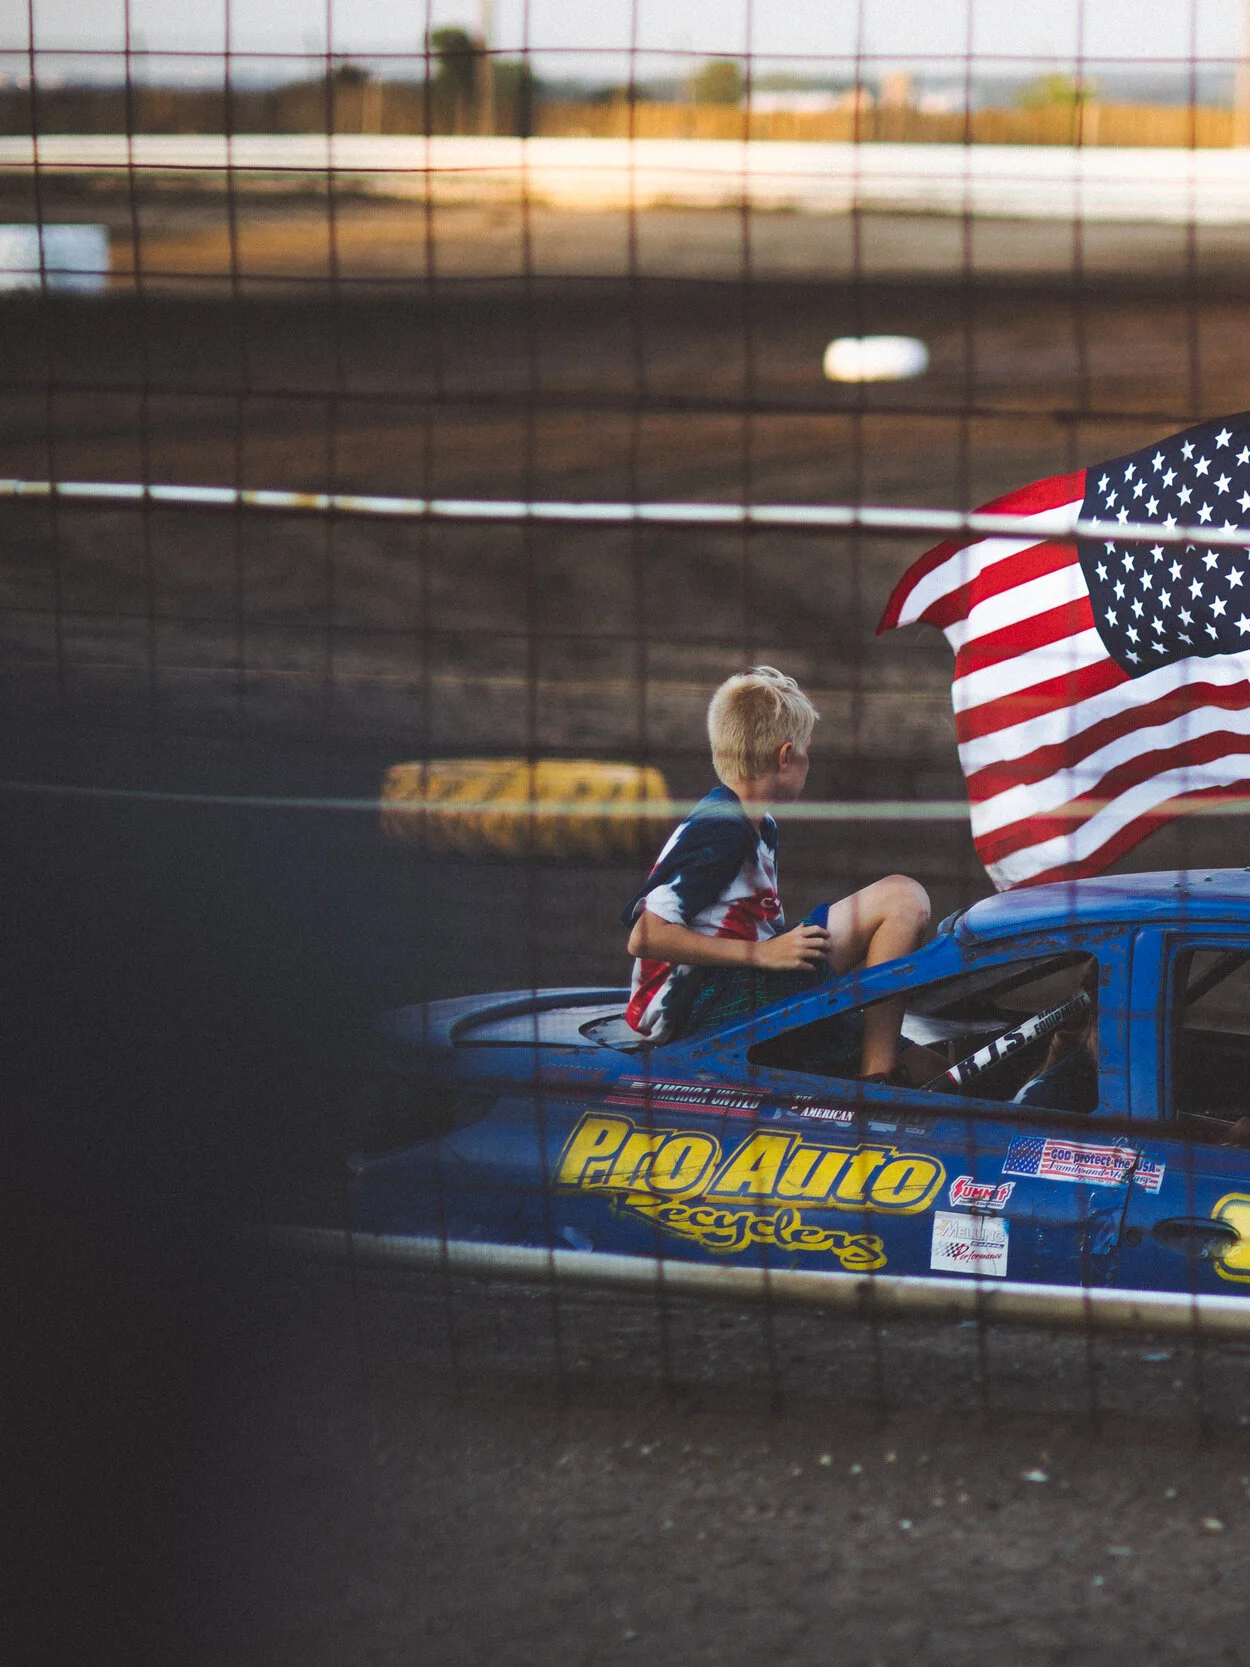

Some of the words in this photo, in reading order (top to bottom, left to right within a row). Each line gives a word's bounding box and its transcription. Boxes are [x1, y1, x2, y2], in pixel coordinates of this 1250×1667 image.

[652, 1083, 710, 1104] AMERICA
[714, 1089, 763, 1109] UNITED
[801, 1106, 855, 1121] AMERICAN
[554, 1112, 720, 1198] Pro
[704, 1130, 946, 1213] Auto
[1051, 1149, 1071, 1160] GOD
[1074, 1151, 1110, 1167] protect
[1113, 1157, 1130, 1168] the
[1085, 1167, 1106, 1177] and
[614, 1196, 886, 1269] Recyclers
[942, 1221, 1005, 1242] MELLING
[953, 1244, 1002, 1263] Performance
